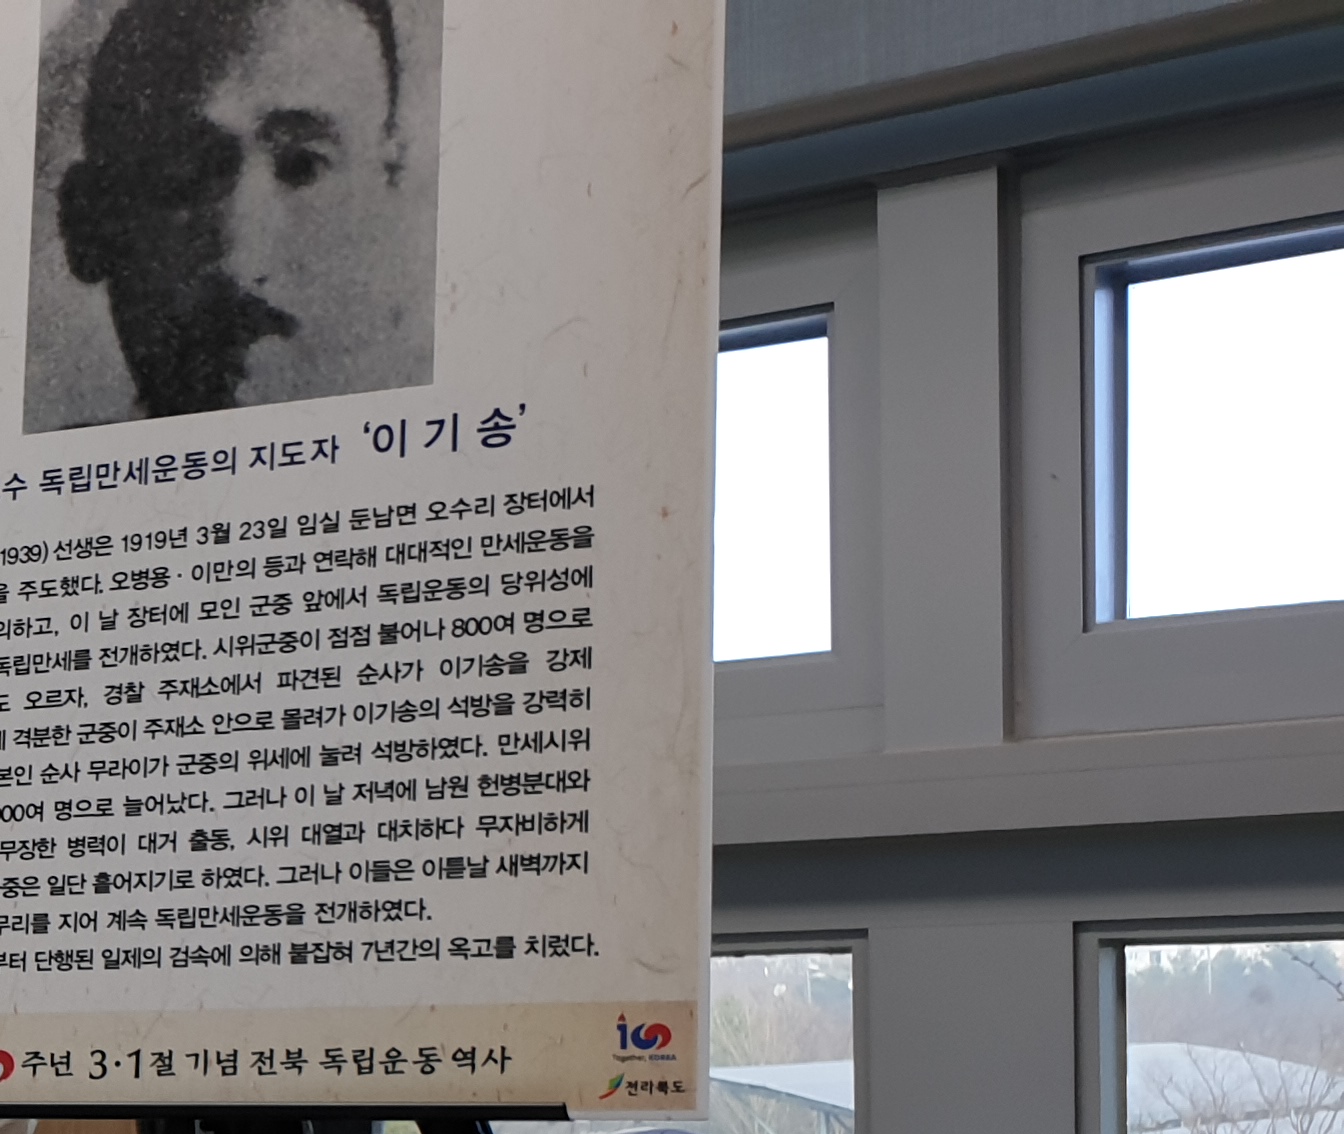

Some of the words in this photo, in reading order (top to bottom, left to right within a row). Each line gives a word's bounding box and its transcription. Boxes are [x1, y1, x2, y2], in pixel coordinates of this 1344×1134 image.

[37, 445, 237, 496] 독립만세운동의
[247, 433, 340, 472] 지도자
[422, 411, 459, 453] 기
[51, 533, 115, 562] 선생은
[119, 525, 188, 553] 1919년
[194, 520, 231, 546] 3월
[237, 514, 288, 541] 23일
[295, 508, 341, 537] 임실
[347, 501, 417, 531] 둔남면
[423, 493, 496, 522] 오수리
[501, 482, 595, 516] 장터에서
[16, 571, 104, 602] 주도했다.
[107, 565, 172, 592] 오병용
[190, 555, 257, 585] 이만의
[261, 551, 307, 579] 등과
[311, 544, 378, 573] 연락해
[384, 534, 473, 566] 대대적인
[479, 524, 596, 558] 만세운동을
[68, 609, 89, 634] 이
[97, 607, 120, 632] 날
[125, 600, 190, 629] 장터에
[195, 595, 241, 621] 모인
[247, 591, 294, 618] 군중
[301, 583, 368, 613] 앞에서
[375, 572, 490, 606] 독립운동의
[499, 563, 593, 596] 당위성에
[97, 637, 208, 669] 전개하였다.
[211, 627, 321, 658] 시위군중이
[325, 622, 371, 650] 점점
[375, 616, 447, 646] 불어나
[449, 610, 515, 639] 800여
[522, 605, 594, 635] 명으로
[21, 684, 89, 711] 오르자,
[102, 679, 146, 706] 경찰
[156, 670, 262, 701] 주재소에서
[275, 664, 342, 692] 파견된
[355, 657, 425, 686] 순사가
[438, 649, 530, 680] 이기송을
[544, 644, 593, 673] 강제
[38, 759, 82, 785] 순사
[85, 753, 170, 782] 무라이가
[174, 748, 240, 776] 군중의
[245, 744, 311, 772] 위세에
[317, 740, 362, 767] 눌려
[369, 733, 488, 763] 석방하였다.
[496, 725, 591, 756] 만세시위
[52, 796, 115, 822] 명으로
[121, 789, 216, 818] 늘어났다.
[221, 784, 288, 811] 그러나
[293, 782, 315, 808] 이
[322, 781, 346, 806] 날
[350, 776, 418, 805] 저녁에
[424, 773, 469, 801] 남원
[475, 767, 592, 798] 헌병분대와
[66, 831, 126, 859] 병력이
[136, 829, 178, 855] 대거
[187, 827, 235, 852] 출동,
[245, 823, 289, 849] 시위
[300, 819, 367, 846] 대열과
[376, 814, 465, 843] 대치하다
[474, 808, 589, 839] 무자비하게
[56, 909, 98, 934] 지어
[105, 907, 149, 932] 계속
[153, 901, 307, 930] 독립만세운동을
[312, 896, 433, 925] 전개하였다.
[33, 946, 94, 972] 단행된
[100, 944, 162, 971] 일제의
[168, 942, 232, 969] 검속에
[237, 941, 282, 967] 의해
[359, 935, 441, 963] 7년간의
[446, 934, 517, 961] 옥고를
[184, 1048, 240, 1078] 기념
[249, 1047, 310, 1077] 전북
[318, 1045, 444, 1077] 독립운동
[450, 1044, 513, 1076] 역사
[624, 1079, 687, 1097] 전라북도
